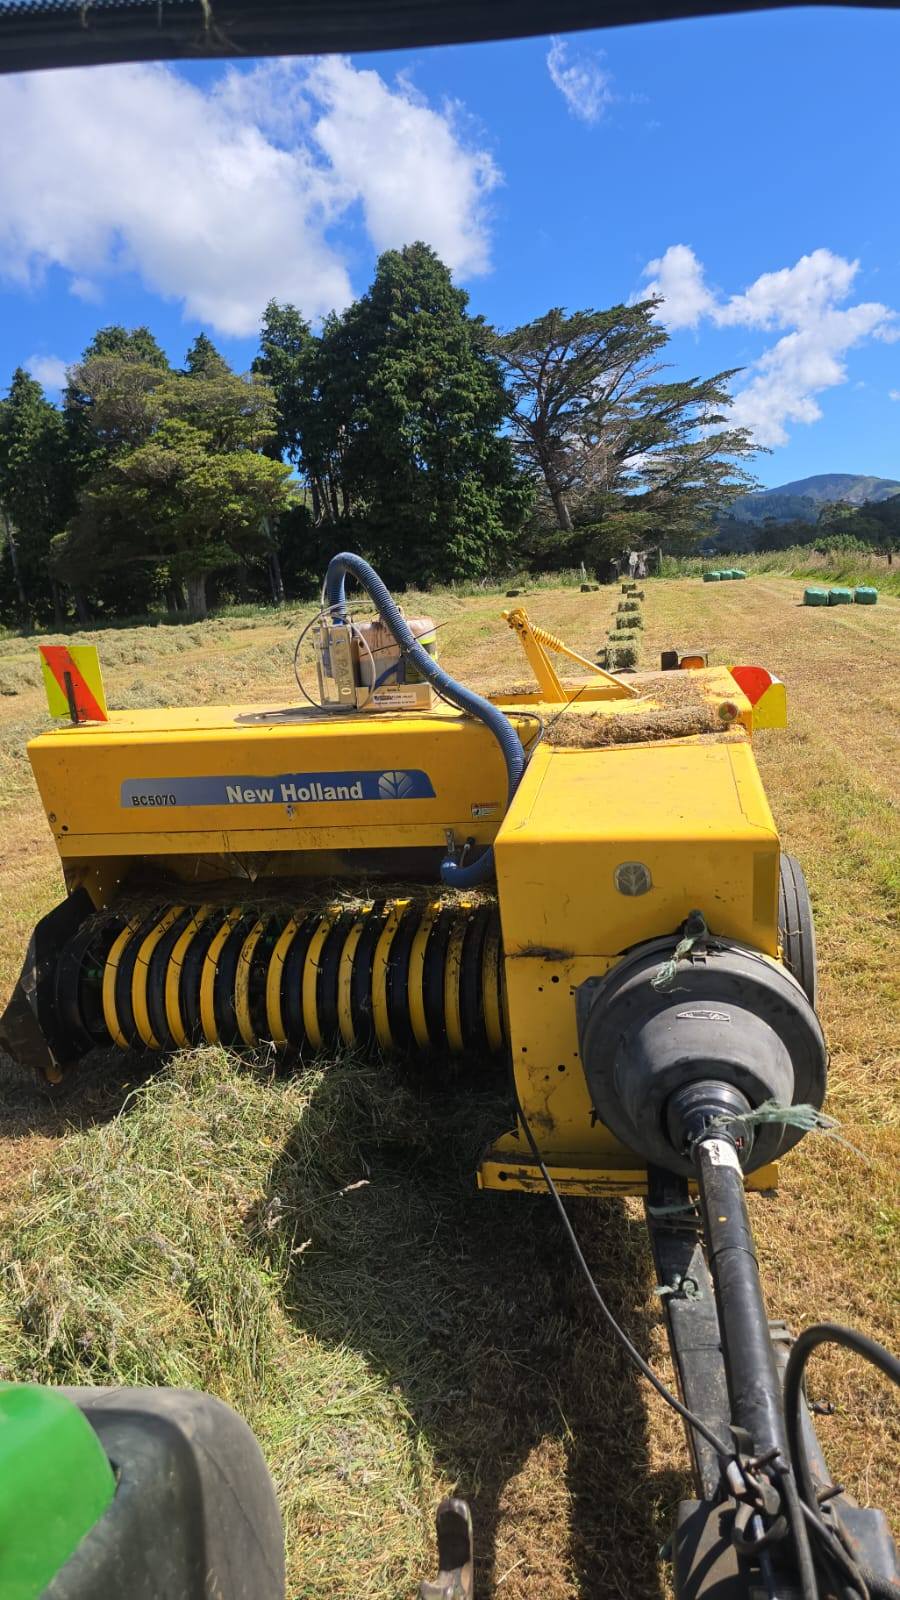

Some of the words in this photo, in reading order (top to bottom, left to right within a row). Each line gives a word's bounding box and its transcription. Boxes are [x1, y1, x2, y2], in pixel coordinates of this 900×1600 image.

[131, 794, 177, 806] BC5070
[226, 785, 274, 803] New
[280, 781, 363, 801] Holland
